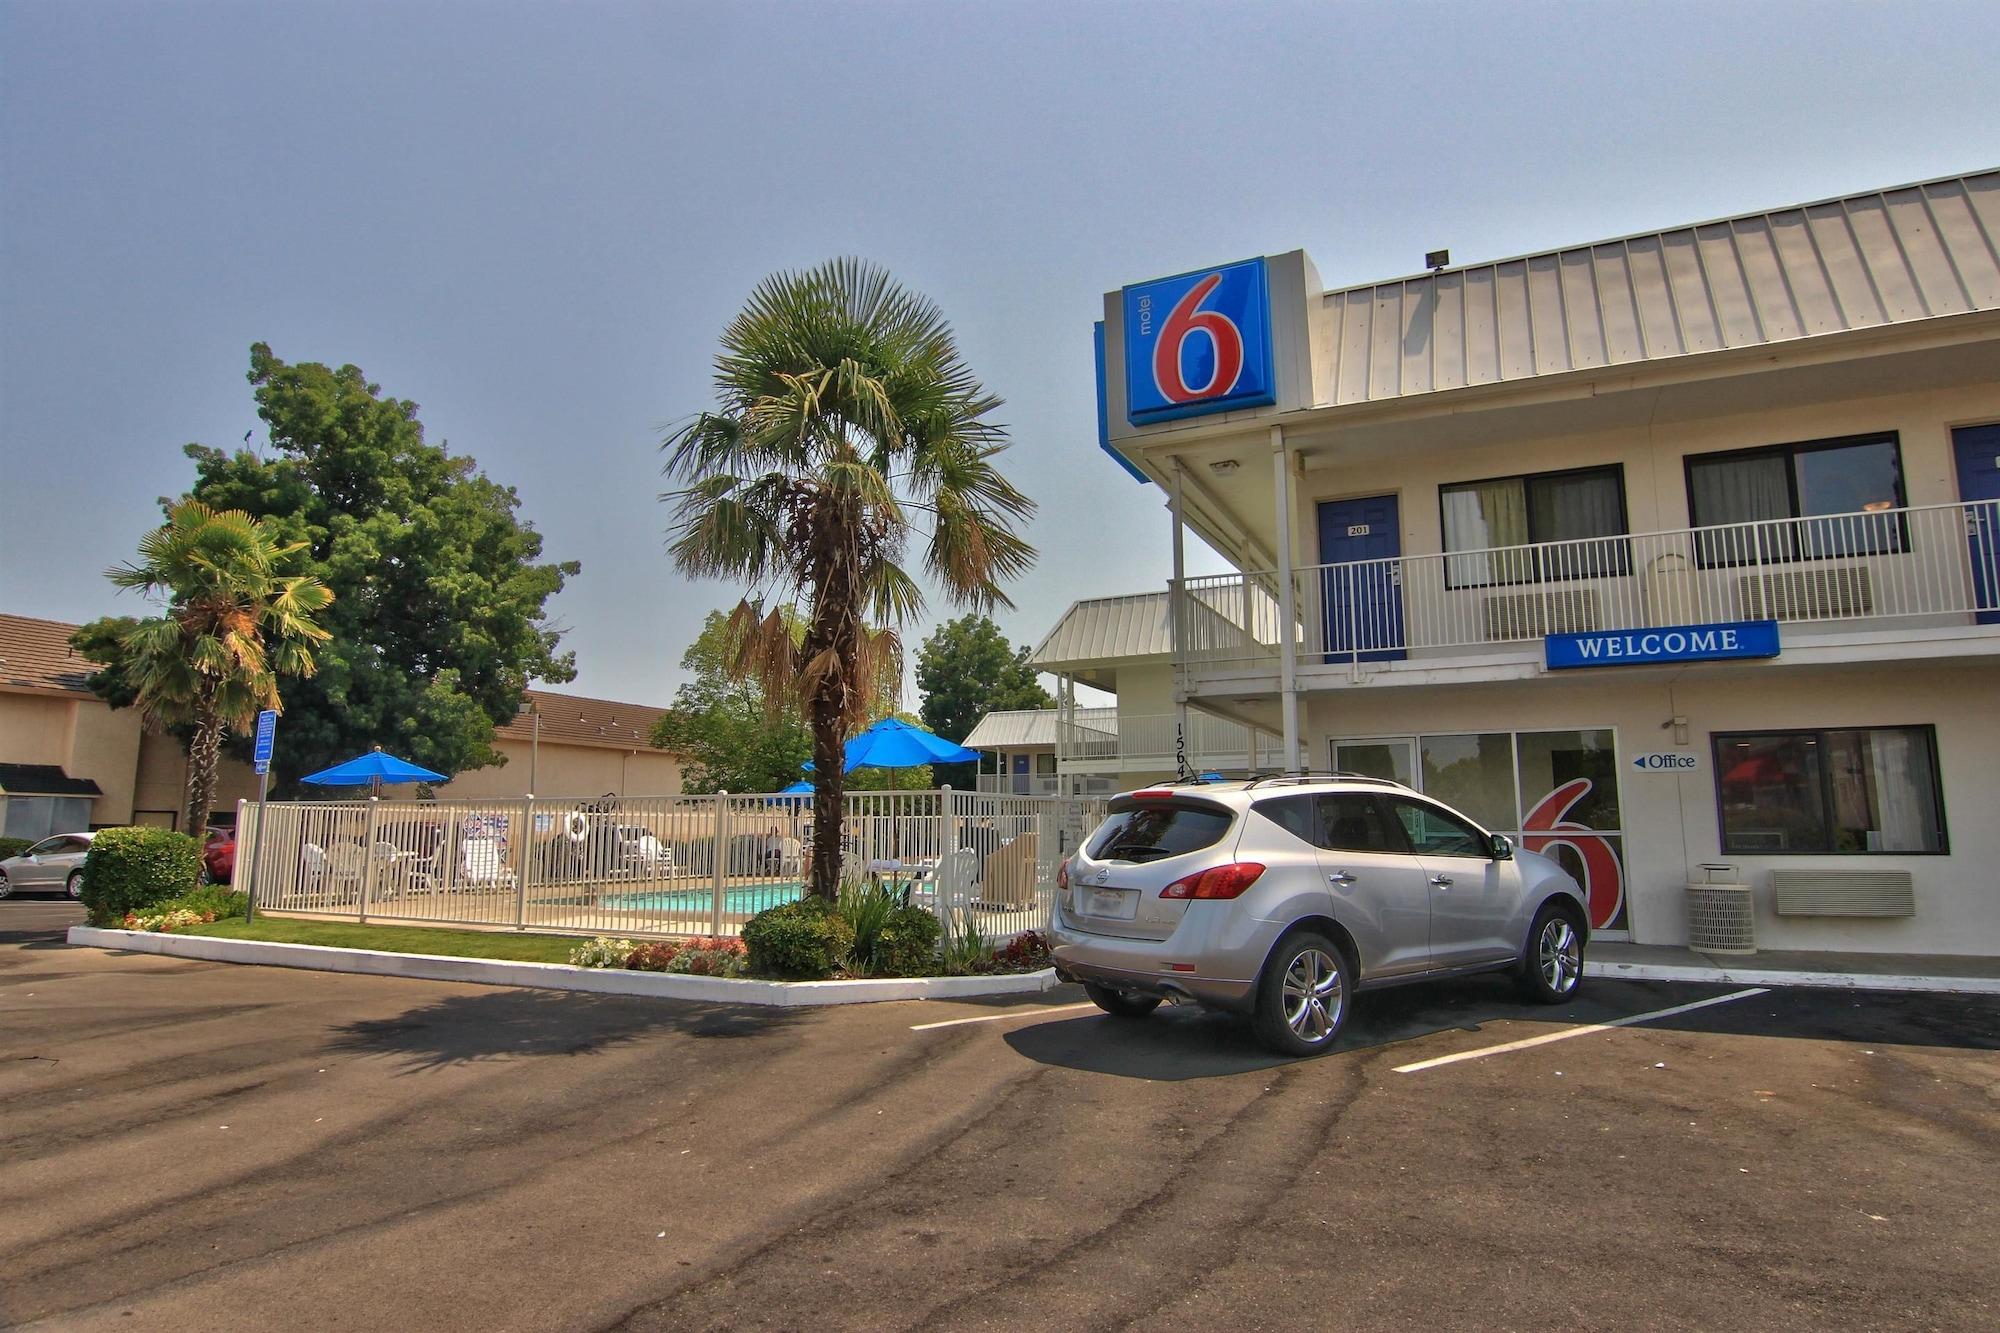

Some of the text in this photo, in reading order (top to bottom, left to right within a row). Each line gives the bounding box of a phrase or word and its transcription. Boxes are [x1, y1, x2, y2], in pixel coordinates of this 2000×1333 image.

[1137, 272, 1245, 404] motel 6
[1351, 526, 1367, 535] 201
[1176, 722, 1185, 778] 1564
[1649, 754, 1695, 768] Office
[1523, 777, 1624, 929] 6
